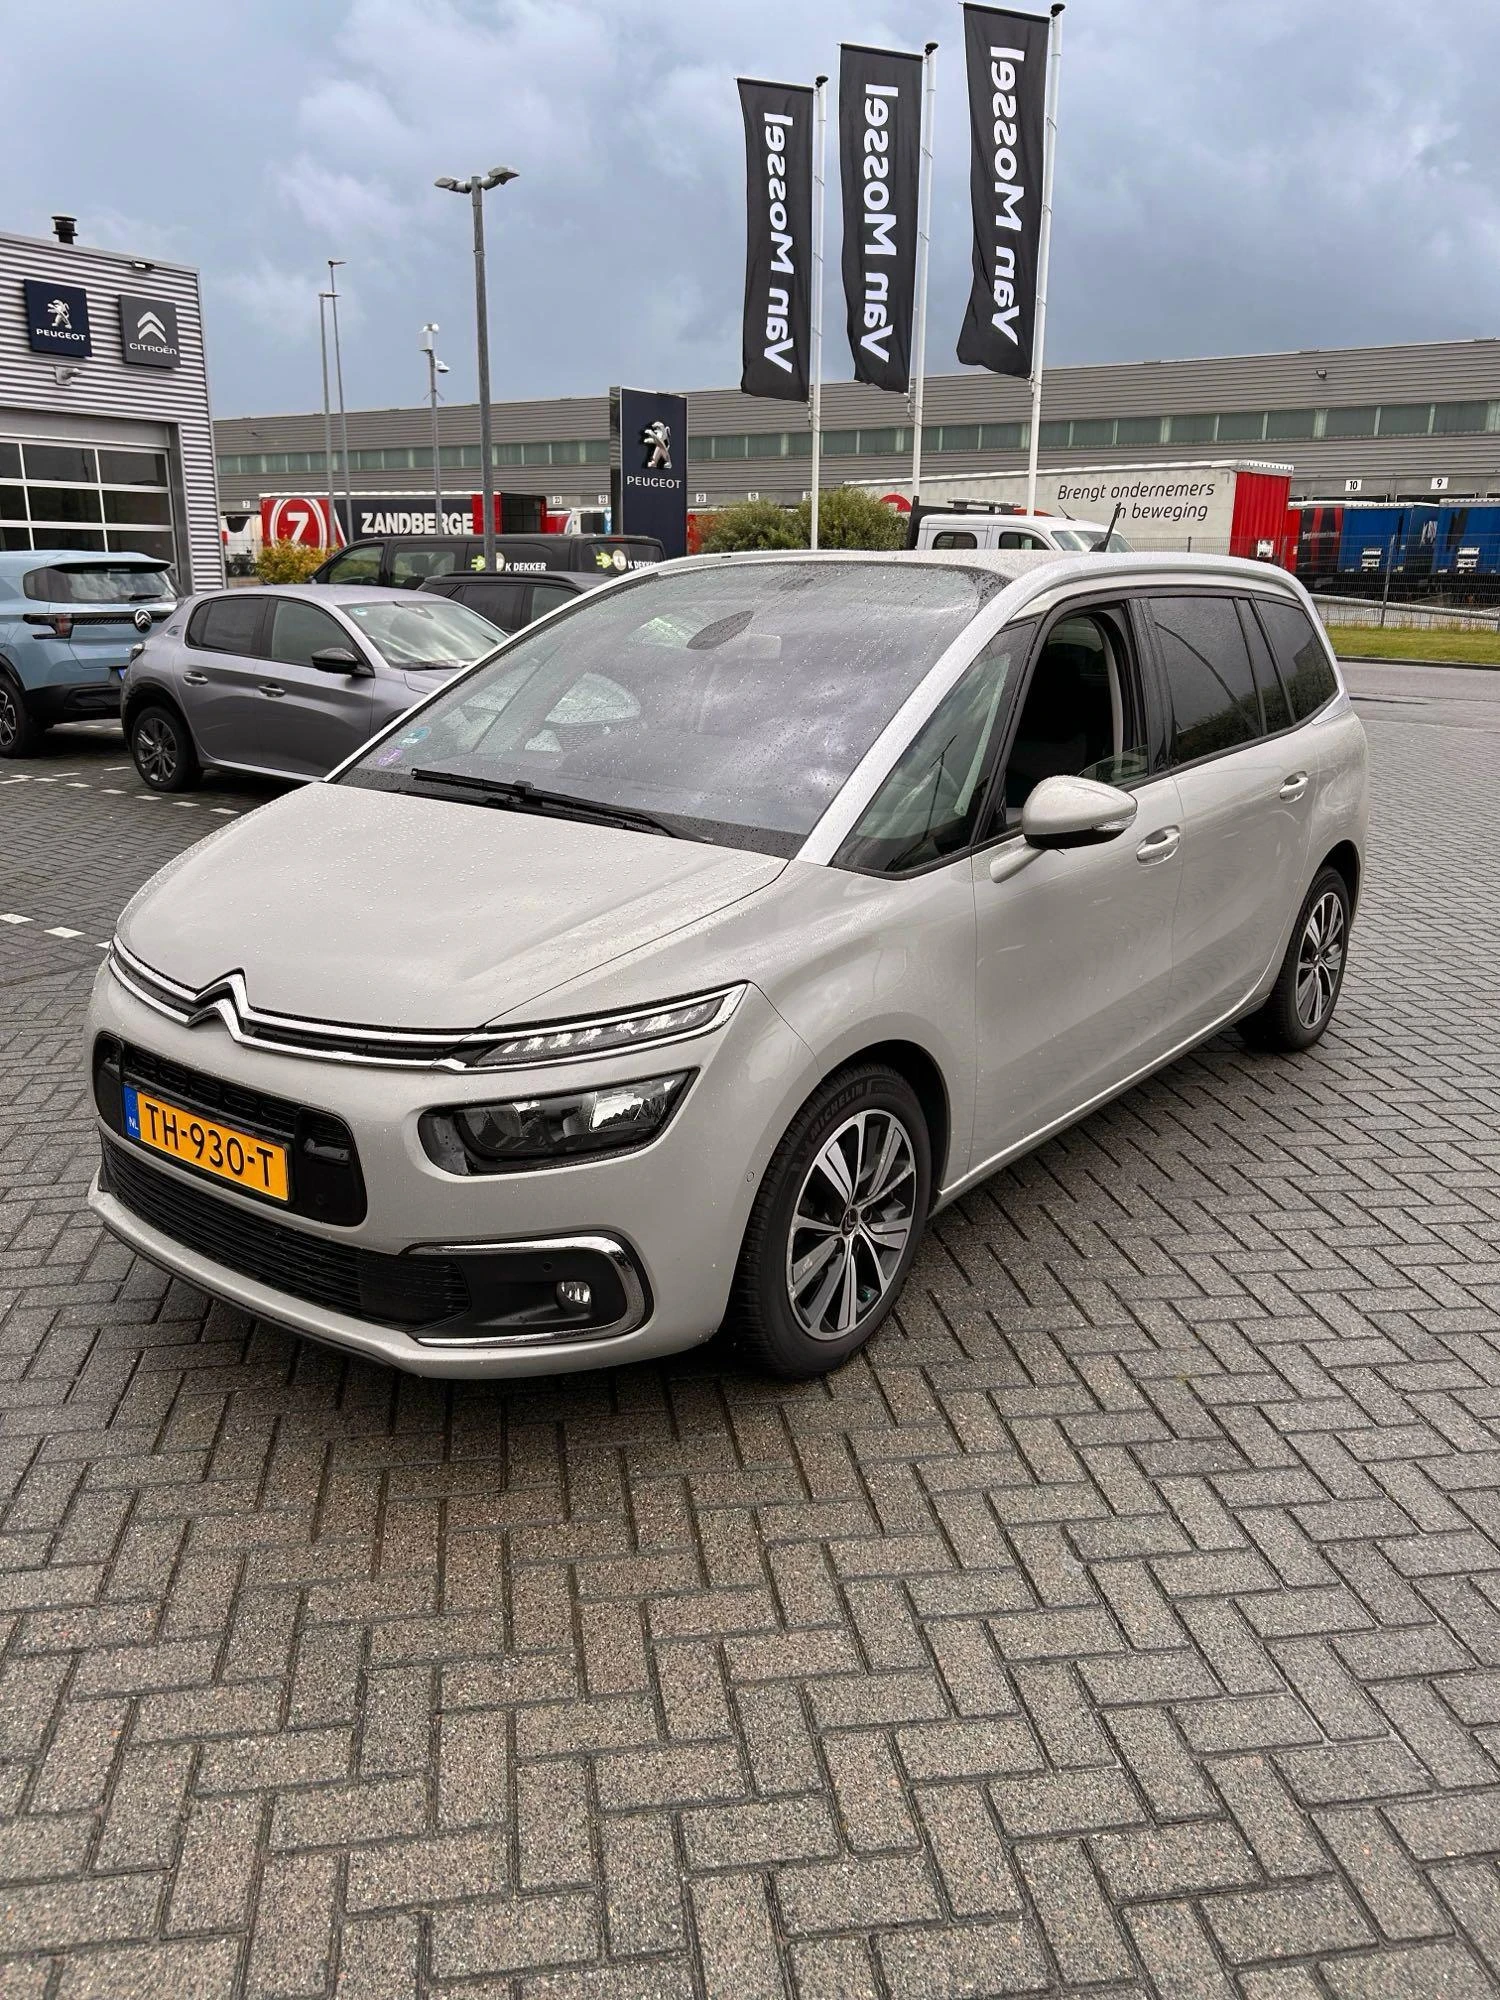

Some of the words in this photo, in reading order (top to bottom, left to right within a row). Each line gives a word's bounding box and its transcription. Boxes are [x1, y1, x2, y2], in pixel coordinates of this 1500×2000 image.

[36, 328, 87, 341] PEUGEOT
[626, 475, 681, 489] PEUGEOT
[1349, 480, 1358, 490] 10
[1436, 478, 1443, 488] 9
[1057, 484, 1107, 502] Brengt
[1110, 482, 1215, 499] ondernemers
[1131, 502, 1208, 521] beweging
[361, 512, 474, 535] ZANDBERGE
[505, 562, 512, 571] K
[513, 562, 547, 571] DEKKER
[128, 1116, 139, 1131] NL
[145, 1102, 274, 1187] TH-930-T
